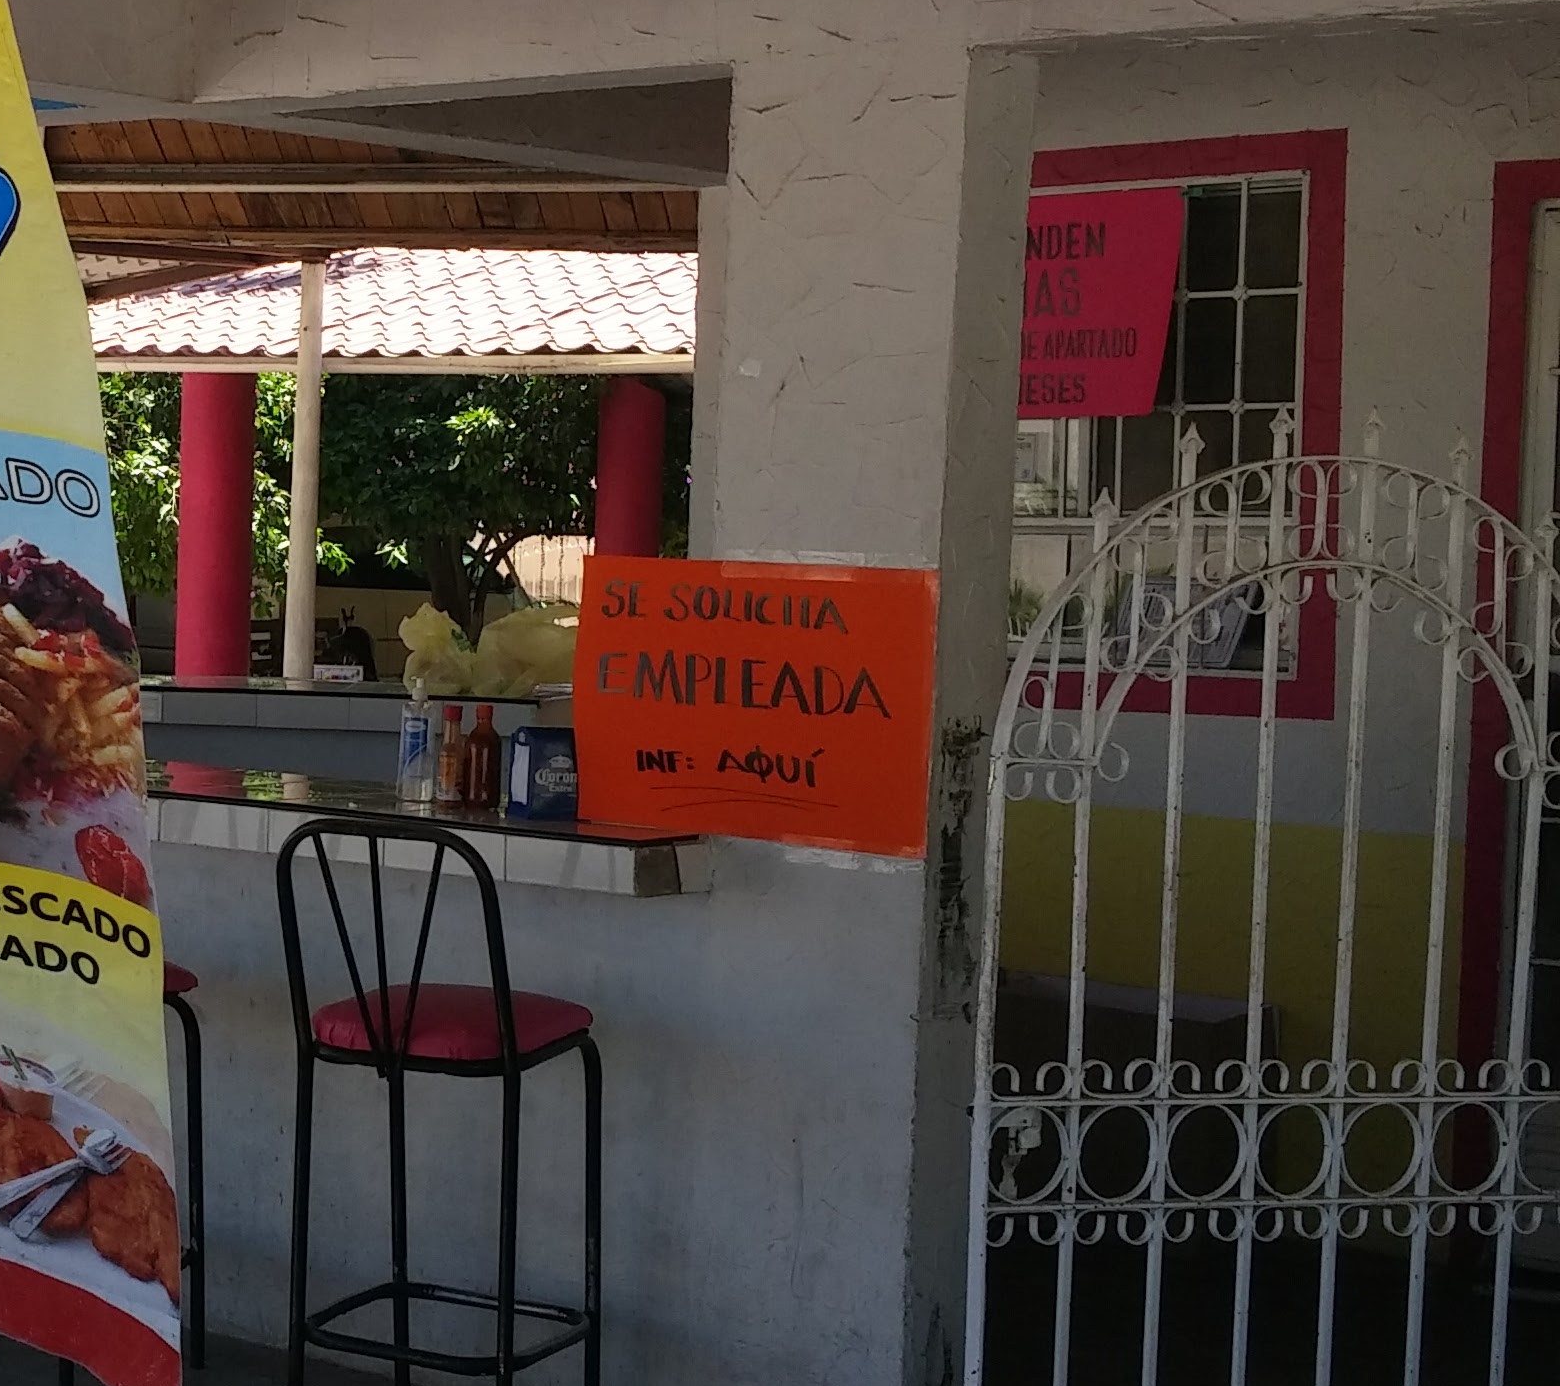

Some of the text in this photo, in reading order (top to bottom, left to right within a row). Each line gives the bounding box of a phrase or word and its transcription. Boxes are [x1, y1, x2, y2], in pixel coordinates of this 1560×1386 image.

[1022, 267, 1081, 317] AS
[1044, 327, 1137, 359] APARTADO
[1018, 373, 1087, 405] ESES
[601, 579, 646, 619] SE
[597, 649, 892, 720] EMPLEADA
[636, 745, 826, 788] INF: AQUÍ
